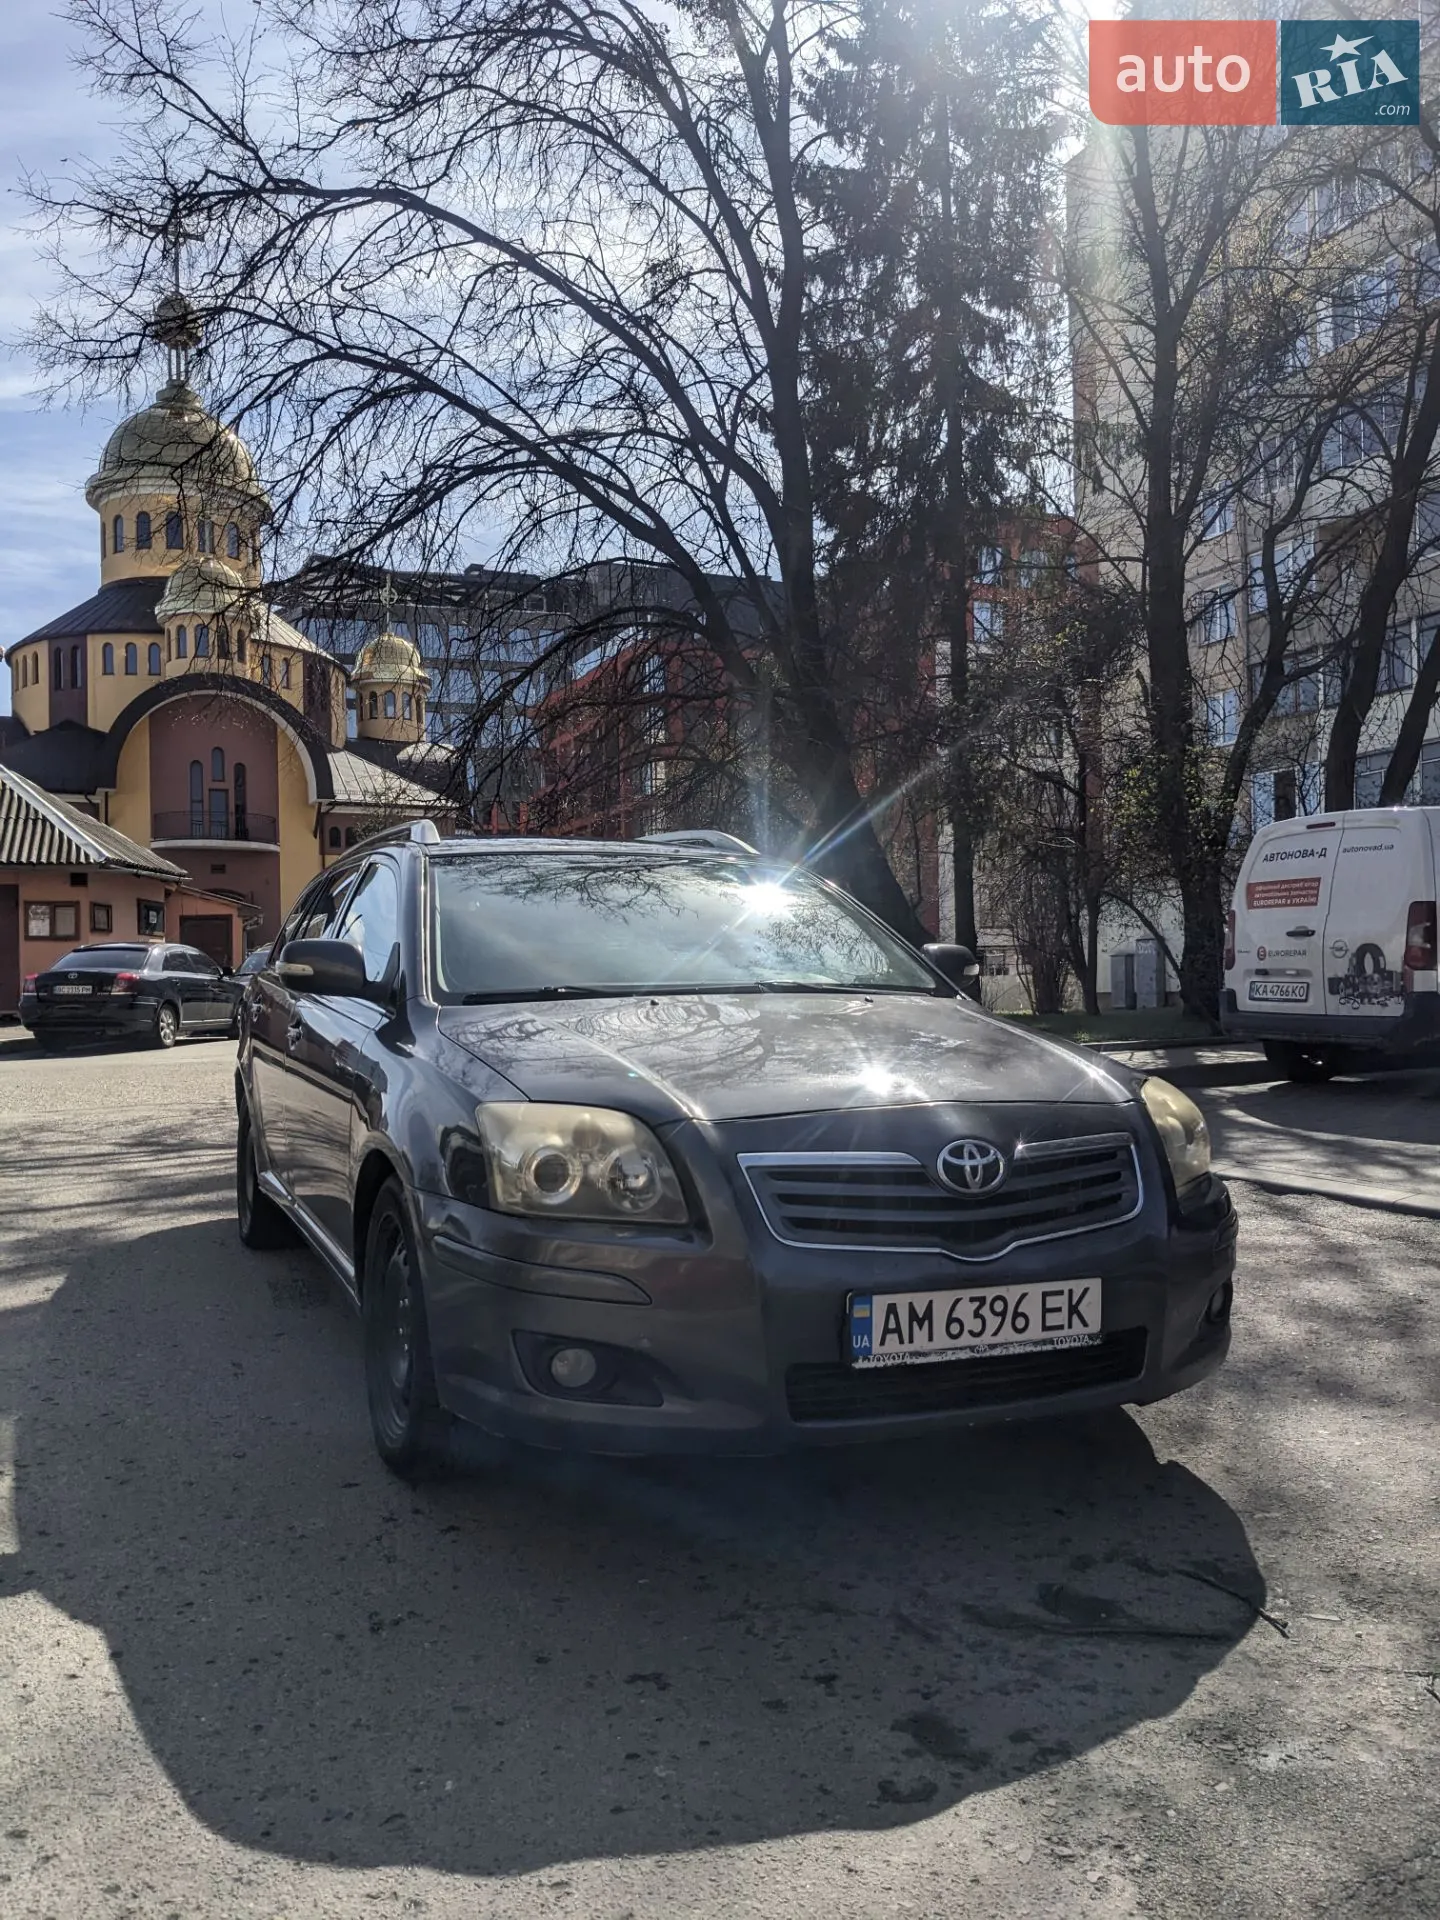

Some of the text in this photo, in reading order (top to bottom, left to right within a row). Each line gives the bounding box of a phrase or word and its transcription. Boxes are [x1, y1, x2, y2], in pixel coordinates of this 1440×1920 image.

[1342, 843, 1394, 853] autonovad.ua
[1262, 847, 1328, 863] АВТОНОВА-Д
[1253, 898, 1286, 907] EUROREPAR
[1268, 949, 1307, 958] EUROREPAR
[1254, 984, 1268, 996] KA
[1269, 984, 1291, 997] 4766
[879, 1287, 1090, 1347] AM 6396 EK
[853, 1335, 870, 1349] UA
[867, 1335, 1090, 1364] TOYOTA TOYOTA
